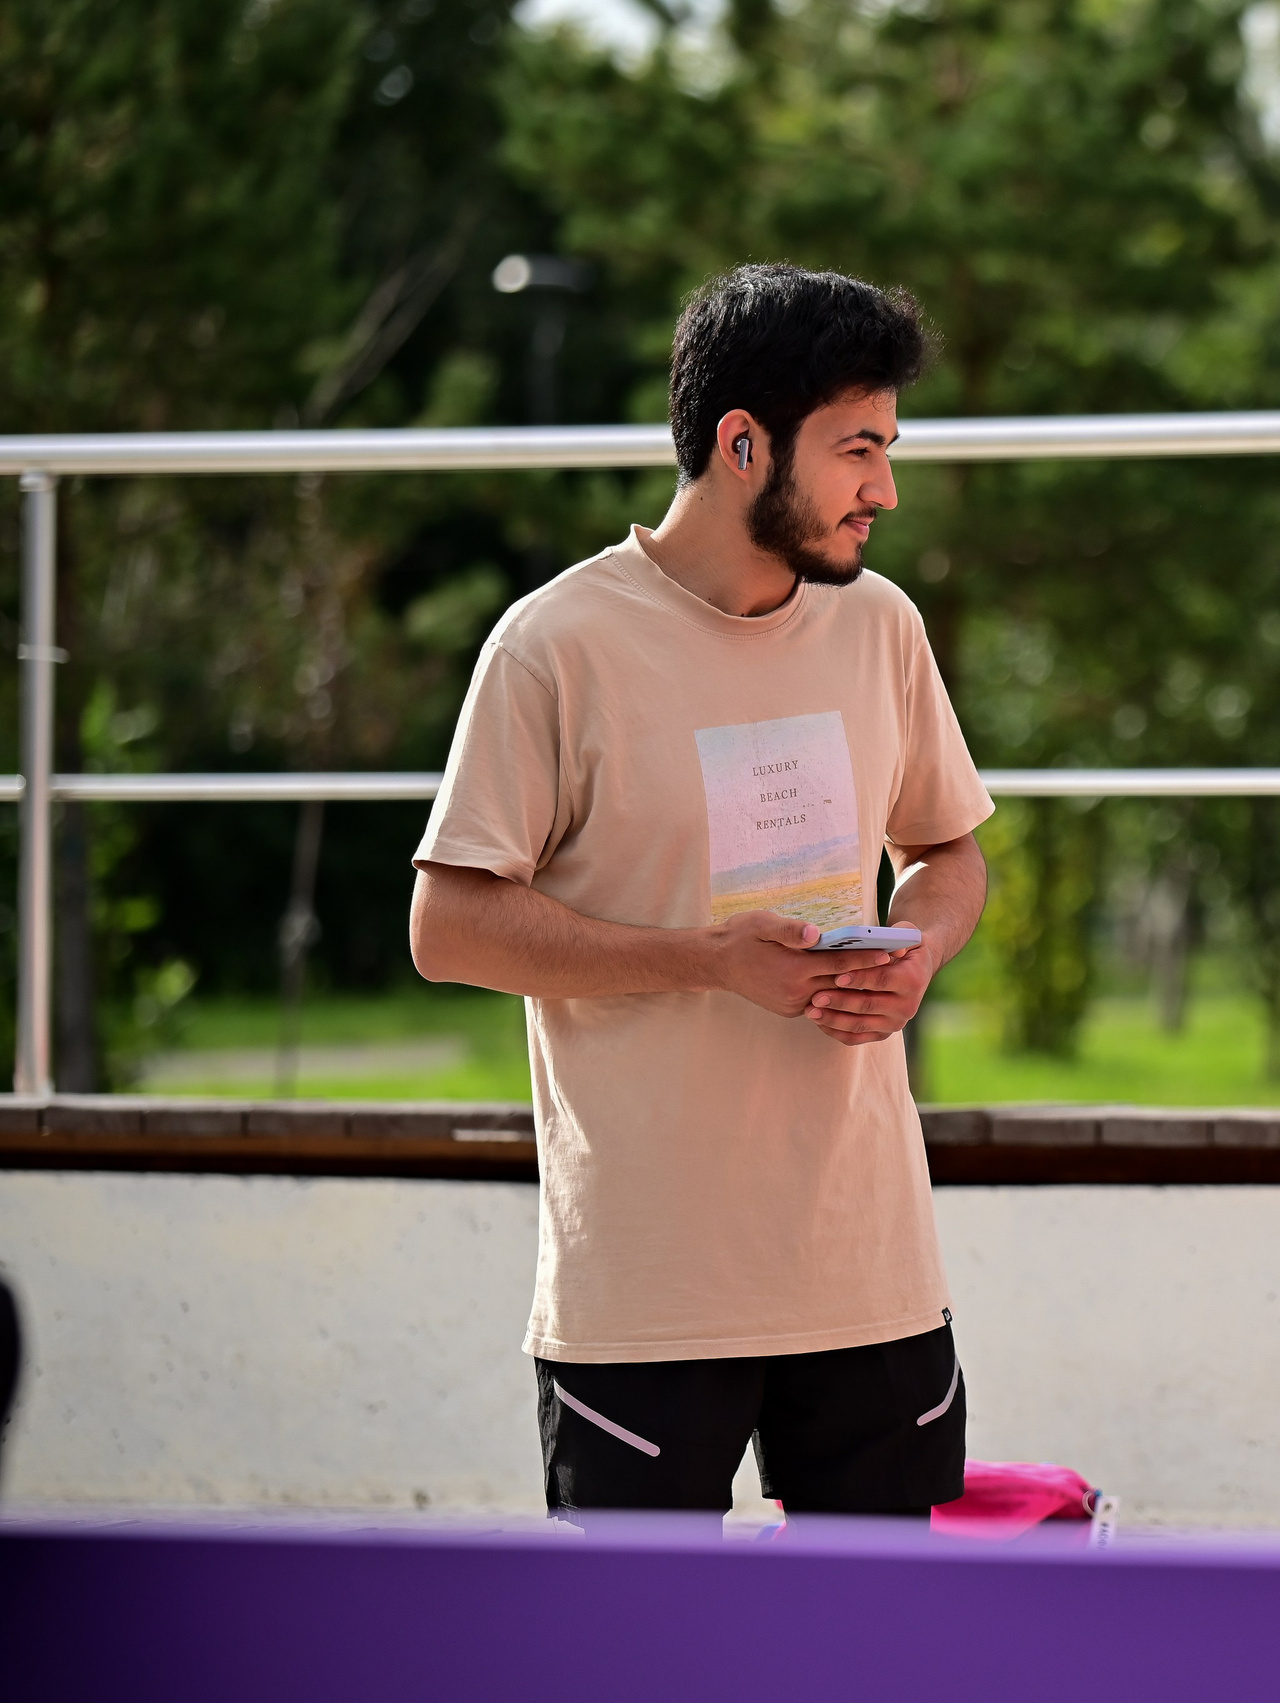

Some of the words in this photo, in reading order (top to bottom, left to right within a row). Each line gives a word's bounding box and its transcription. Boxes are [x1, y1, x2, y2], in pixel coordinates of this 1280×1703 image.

[752, 760, 799, 777] LUXURY
[760, 788, 798, 803] BEACH
[756, 814, 807, 831] RENTALS
